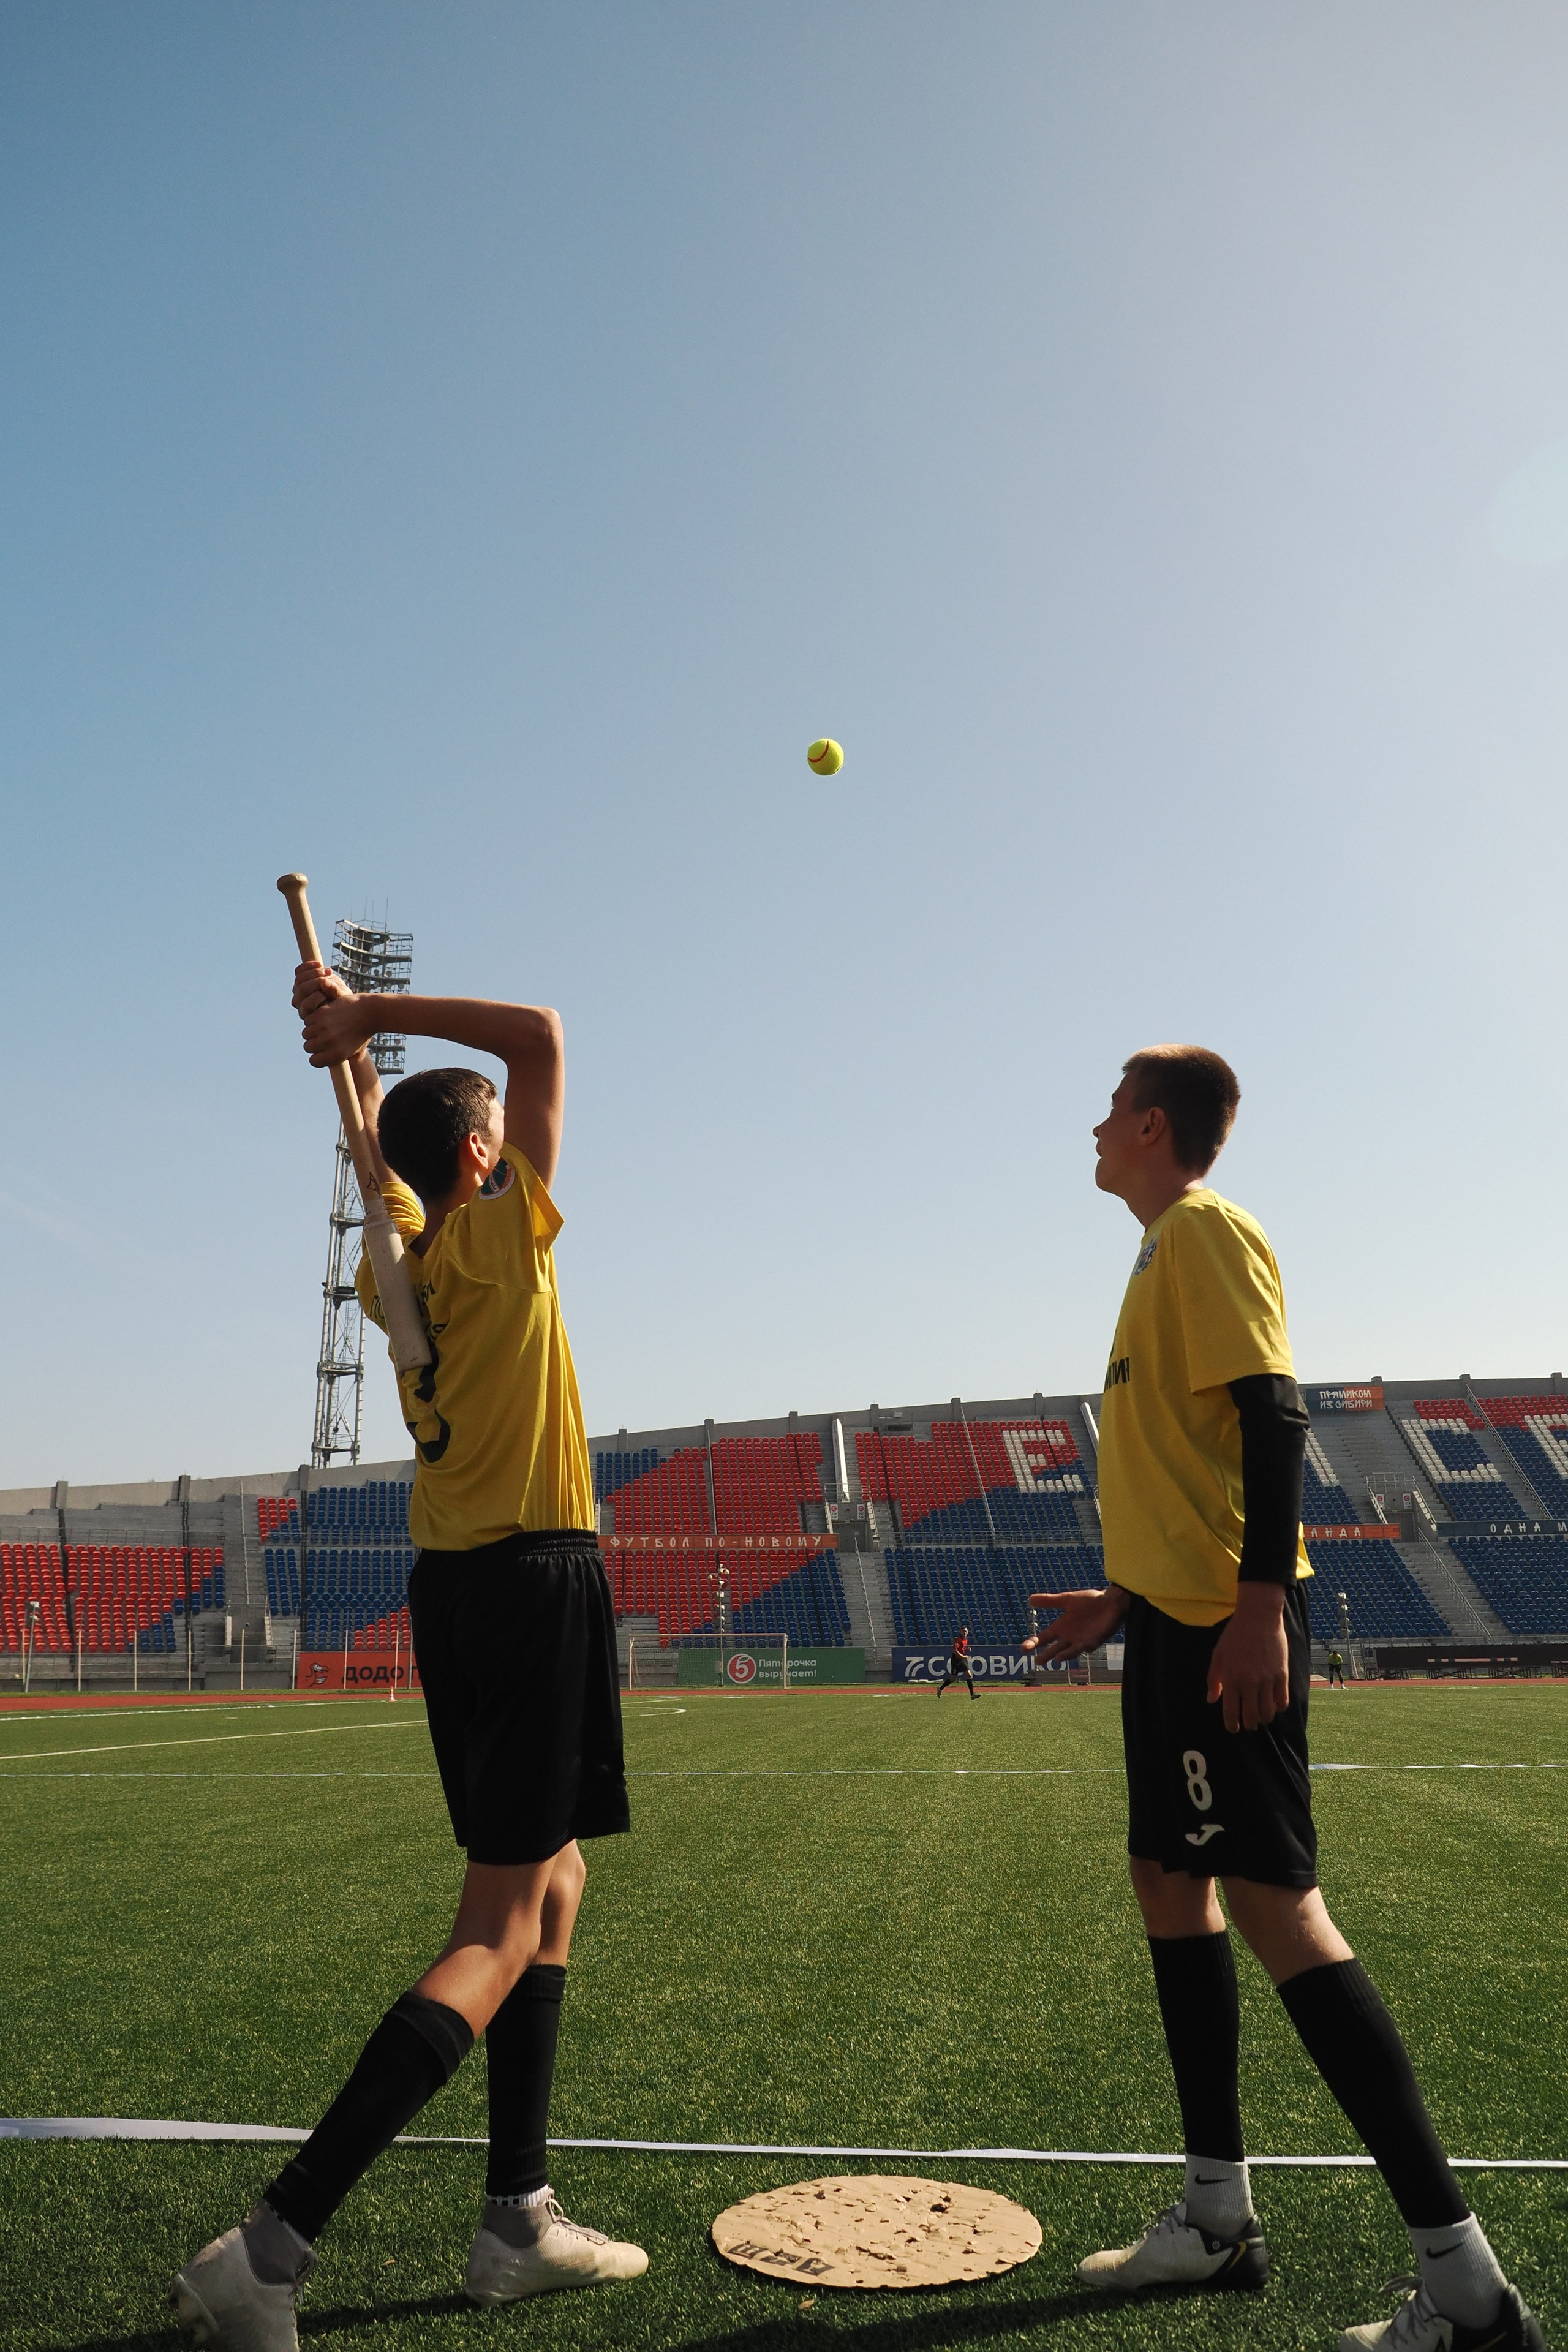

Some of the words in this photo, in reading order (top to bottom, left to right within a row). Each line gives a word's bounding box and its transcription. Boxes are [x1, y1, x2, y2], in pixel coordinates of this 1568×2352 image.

[1319, 1389, 1371, 1399] ПРЯМИКОМ
[1335, 1400, 1372, 1408] СИБИРИ
[1310, 1527, 1362, 1538] АНДА
[1490, 1522, 1541, 1534] ОДНА
[610, 1536, 690, 1548] ФУТБОЛ
[342, 1665, 404, 1683] ДОДО
[1183, 1750, 1213, 1811] 8
